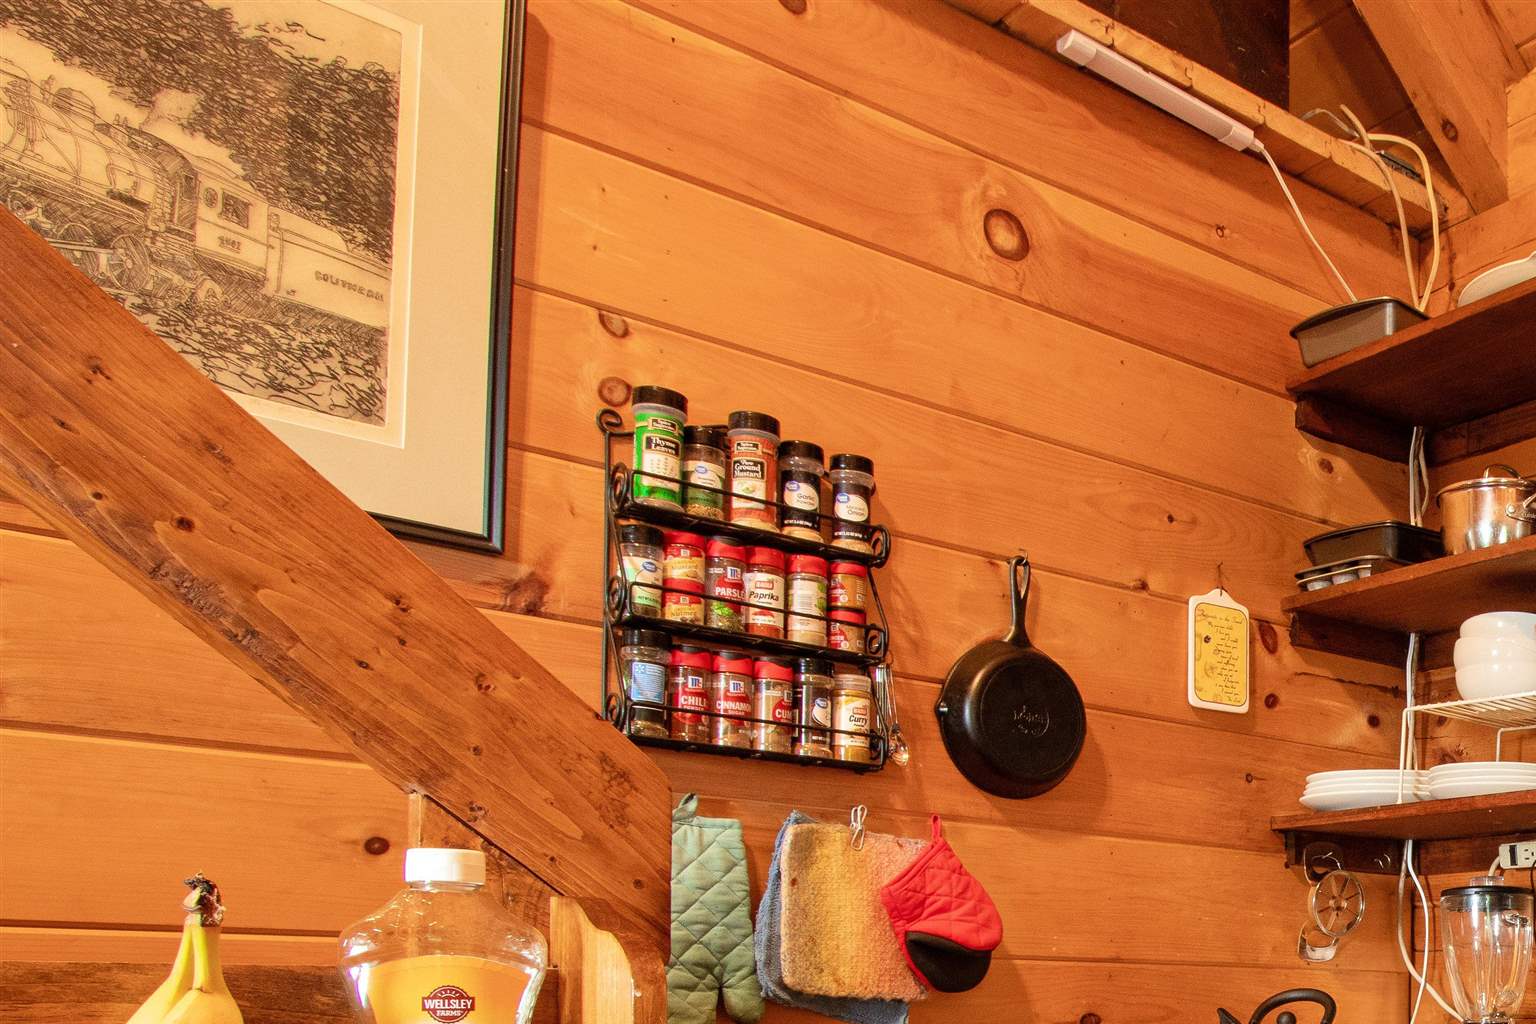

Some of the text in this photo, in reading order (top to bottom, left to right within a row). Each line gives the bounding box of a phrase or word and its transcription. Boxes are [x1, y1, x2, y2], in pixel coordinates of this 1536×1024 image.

[734, 463, 761, 472] Ground
[715, 587, 745, 599] PARSLE
[748, 591, 780, 602] Paprika
[849, 715, 868, 726] Curry
[423, 999, 473, 1010] WELLSLEY
[436, 1009, 462, 1017] FARMS
